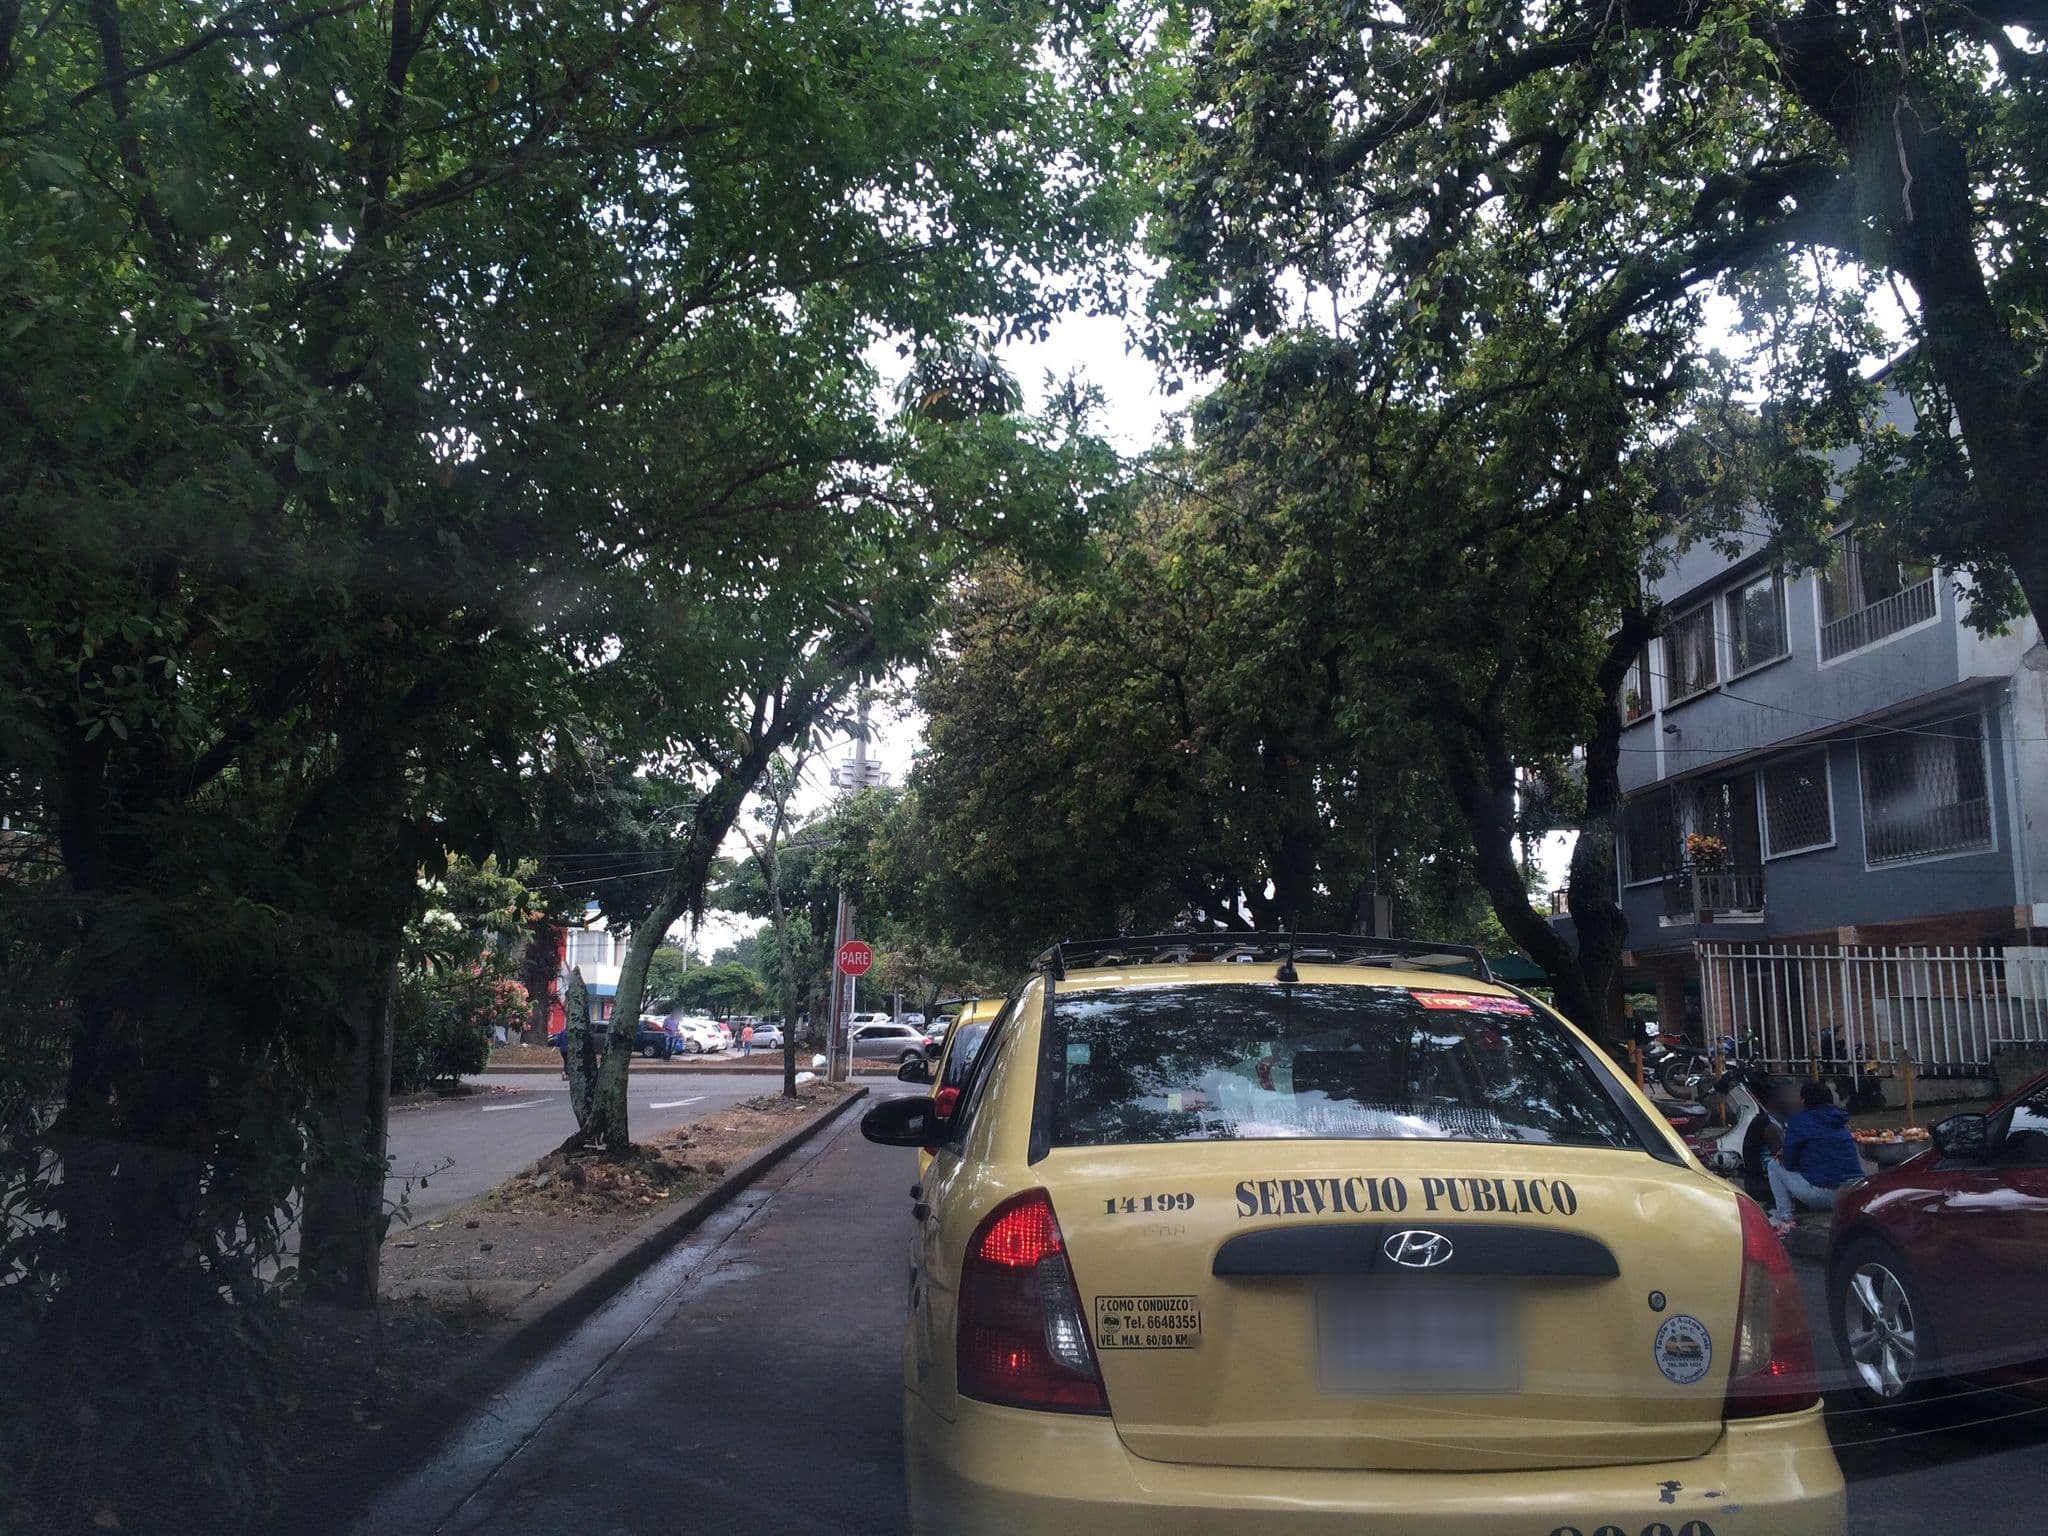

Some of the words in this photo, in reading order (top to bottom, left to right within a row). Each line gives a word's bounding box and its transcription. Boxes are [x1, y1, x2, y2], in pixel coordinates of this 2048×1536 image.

[841, 951, 869, 966] PARE
[1104, 1192, 1195, 1215] 14199
[1235, 1176, 1407, 1218] SERVICIO
[1423, 1176, 1577, 1216] PUBLICO
[1100, 1299, 1134, 1312] ¿COMO
[1124, 1316, 1145, 1329] Tel.
[1147, 1315, 1197, 1329] 6648355
[1146, 1335, 1173, 1346] 60/80
